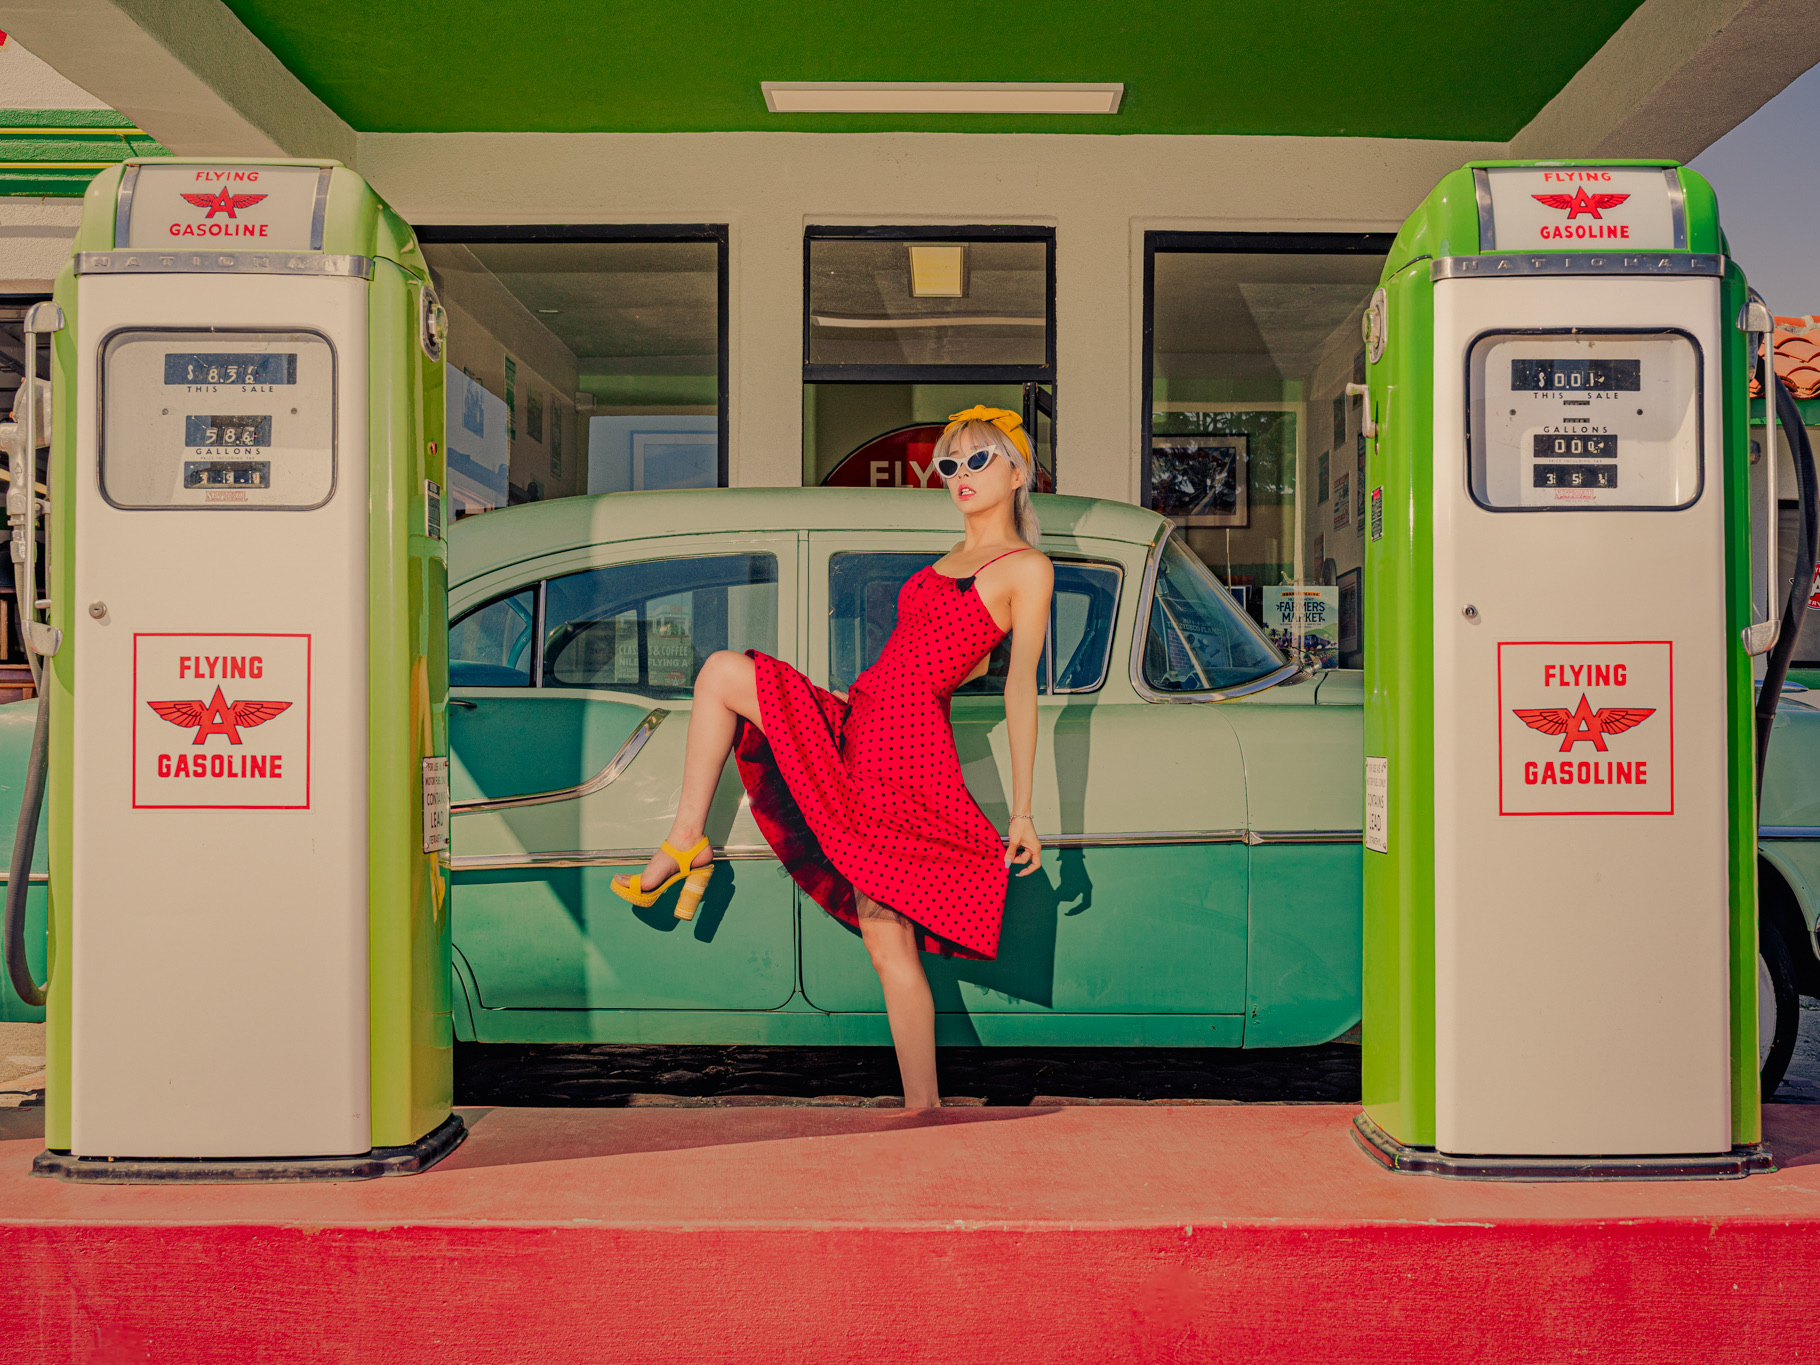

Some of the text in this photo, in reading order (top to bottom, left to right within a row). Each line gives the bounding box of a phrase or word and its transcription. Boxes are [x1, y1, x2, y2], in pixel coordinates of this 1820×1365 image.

[195, 171, 260, 182] FLYING
[1543, 171, 1612, 182] FLYING
[205, 185, 238, 219] A
[1566, 186, 1603, 220] A
[169, 223, 269, 238] GASOLINE
[1539, 224, 1630, 240] GASOLINE
[91, 255, 348, 271] NATIONAL
[1462, 257, 1706, 271] NATIONAL
[187, 385, 274, 393] THIS SALE
[870, 461, 948, 488] FLY
[1279, 601, 1326, 612] FARMERS
[1282, 612, 1323, 623] MARKET
[179, 656, 263, 679] FLYING
[648, 658, 679, 667] FLYING
[681, 658, 688, 667] A
[1544, 664, 1627, 687] FLYING
[192, 684, 243, 745] A
[1559, 692, 1609, 752] A
[158, 753, 283, 778] GASOLINE
[1524, 761, 1647, 785] GASOLINE
[430, 812, 442, 828] LEAD
[1369, 813, 1381, 832] LEAD
